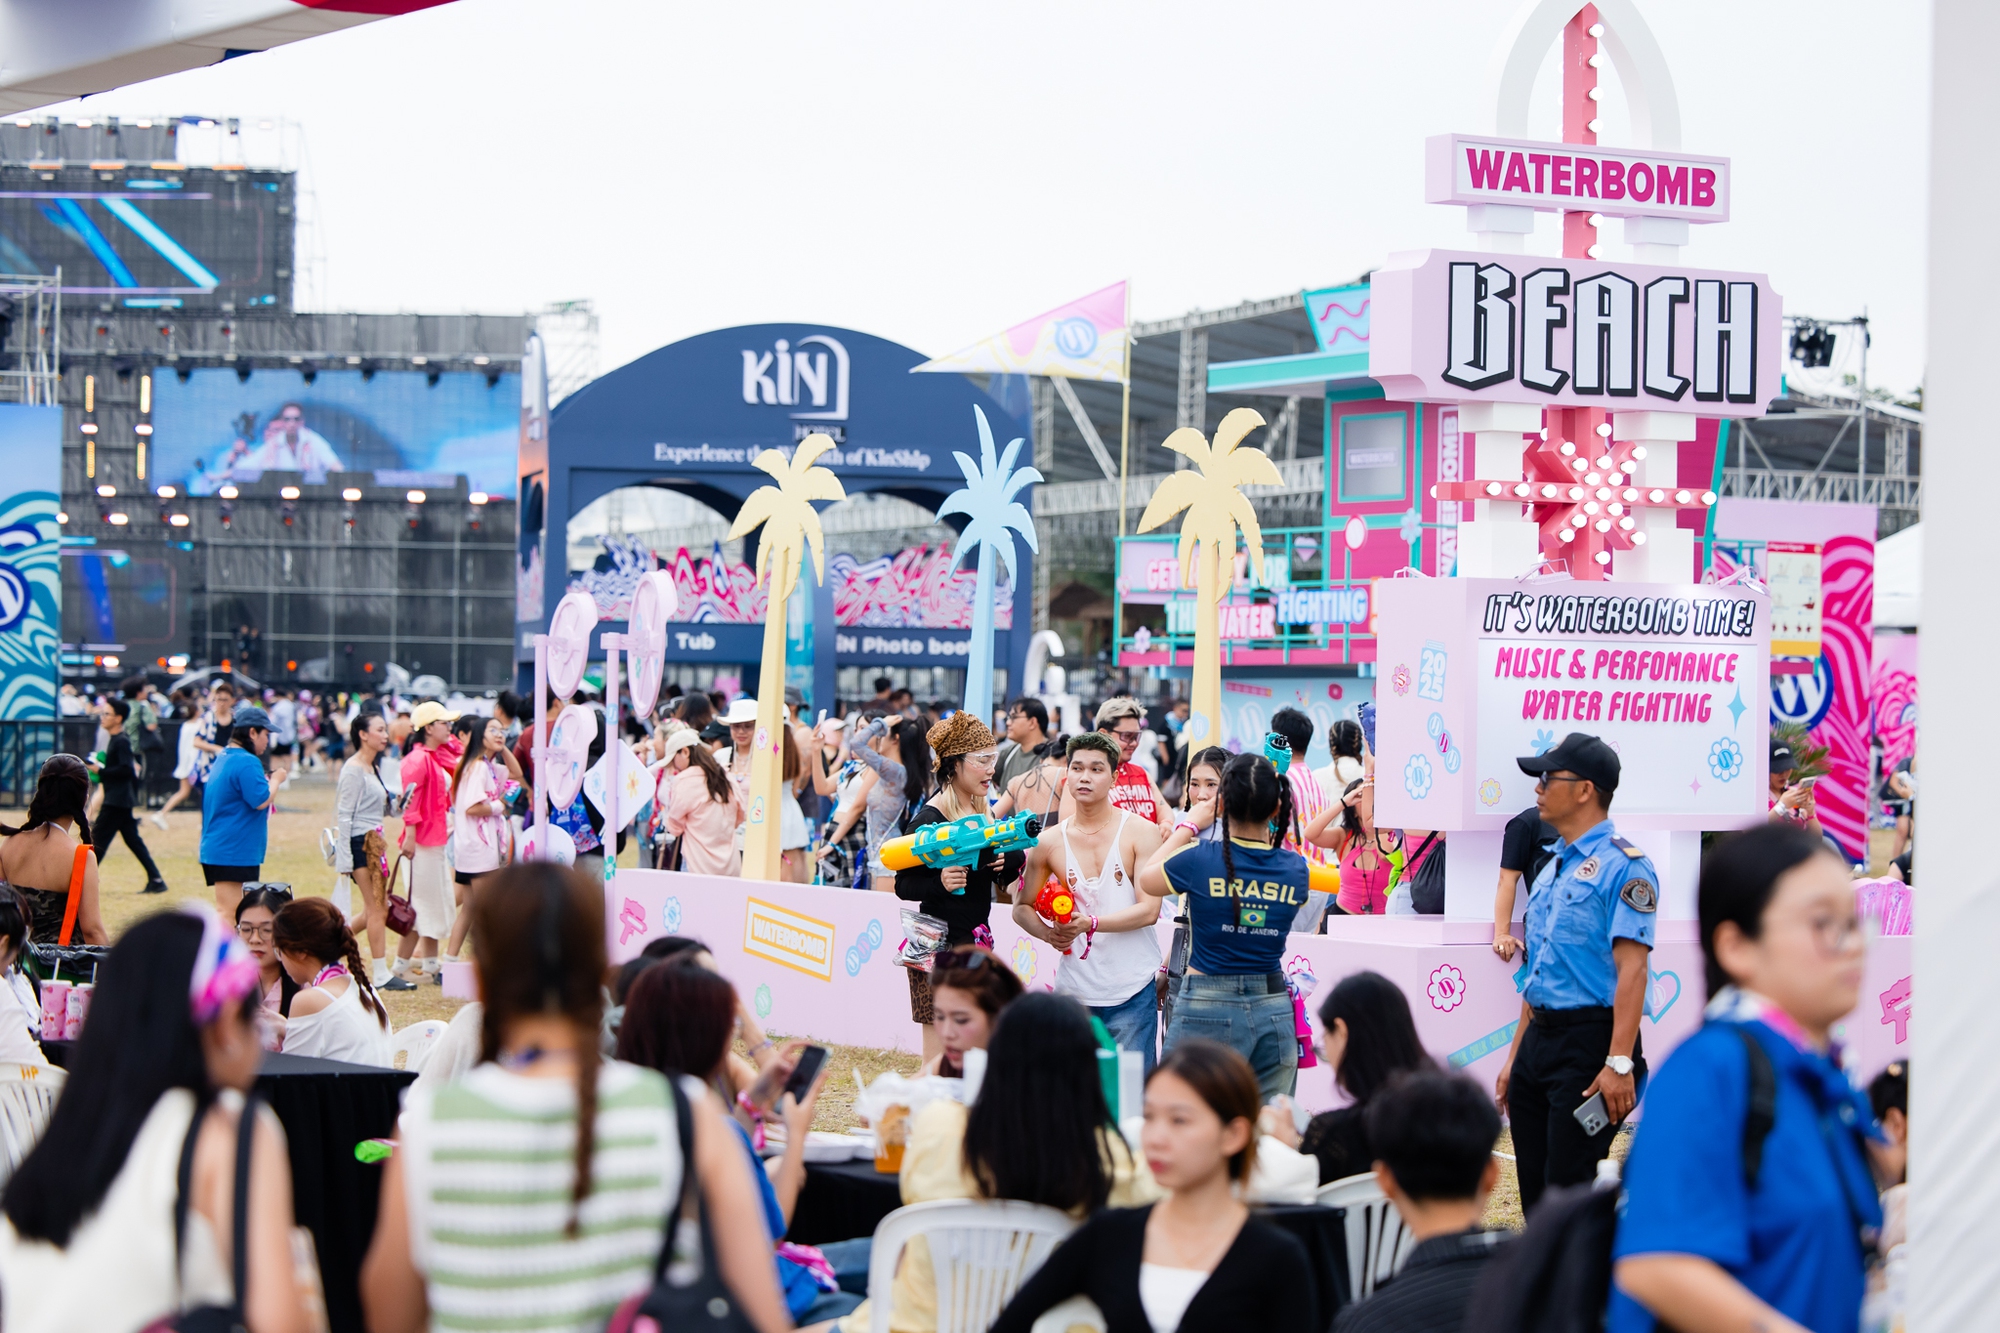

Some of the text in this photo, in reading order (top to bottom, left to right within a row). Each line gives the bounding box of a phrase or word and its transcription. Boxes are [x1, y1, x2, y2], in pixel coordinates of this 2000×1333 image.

[1465, 148, 1716, 208] WATERBOMB
[1441, 261, 1759, 405] BEACH
[654, 442, 745, 465] Experience
[846, 447, 863, 466] of
[1442, 416, 1458, 577] WATEROMB
[1146, 558, 1178, 592] GET
[1277, 588, 1368, 625] FIGHTING
[1483, 591, 1757, 637] IT'S WATERBOMB TIME!
[675, 632, 716, 650] Tub
[836, 633, 858, 653] iN
[862, 635, 924, 655] Photo
[1495, 647, 1739, 683] MUSIC & PERFOMANCE
[1522, 689, 1712, 723] WATER FIGHTING
[1209, 877, 1298, 905] BRASIL
[753, 918, 825, 959] WATERBOMB
[1221, 923, 1279, 937] RIO DE JANEIRO
